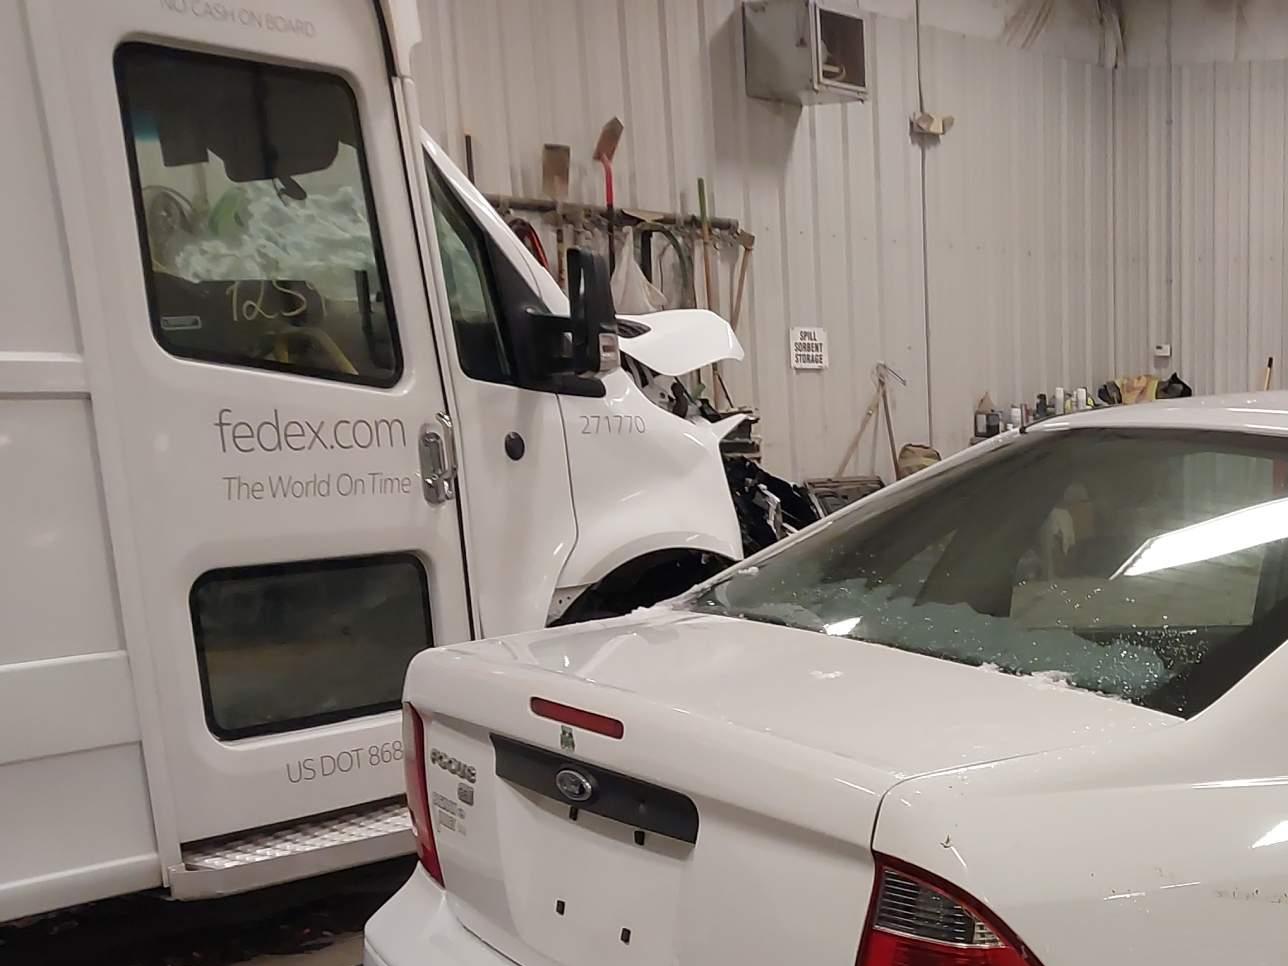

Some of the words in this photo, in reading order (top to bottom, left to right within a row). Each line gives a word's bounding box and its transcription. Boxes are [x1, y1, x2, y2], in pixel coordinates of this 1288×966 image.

[191, 1, 236, 23] CASH
[239, 8, 263, 29] ON
[266, 12, 316, 39] BOARD
[799, 330, 817, 341] SPILL
[794, 342, 823, 353] SORBENT
[794, 353, 823, 364] STORAGE
[214, 408, 407, 453] fedex.com
[579, 415, 646, 434] 271770
[222, 475, 264, 500] The
[269, 473, 331, 499] World
[337, 472, 366, 497] On
[367, 472, 412, 495] Time
[286, 758, 317, 783] US
[320, 747, 364, 777] DOT
